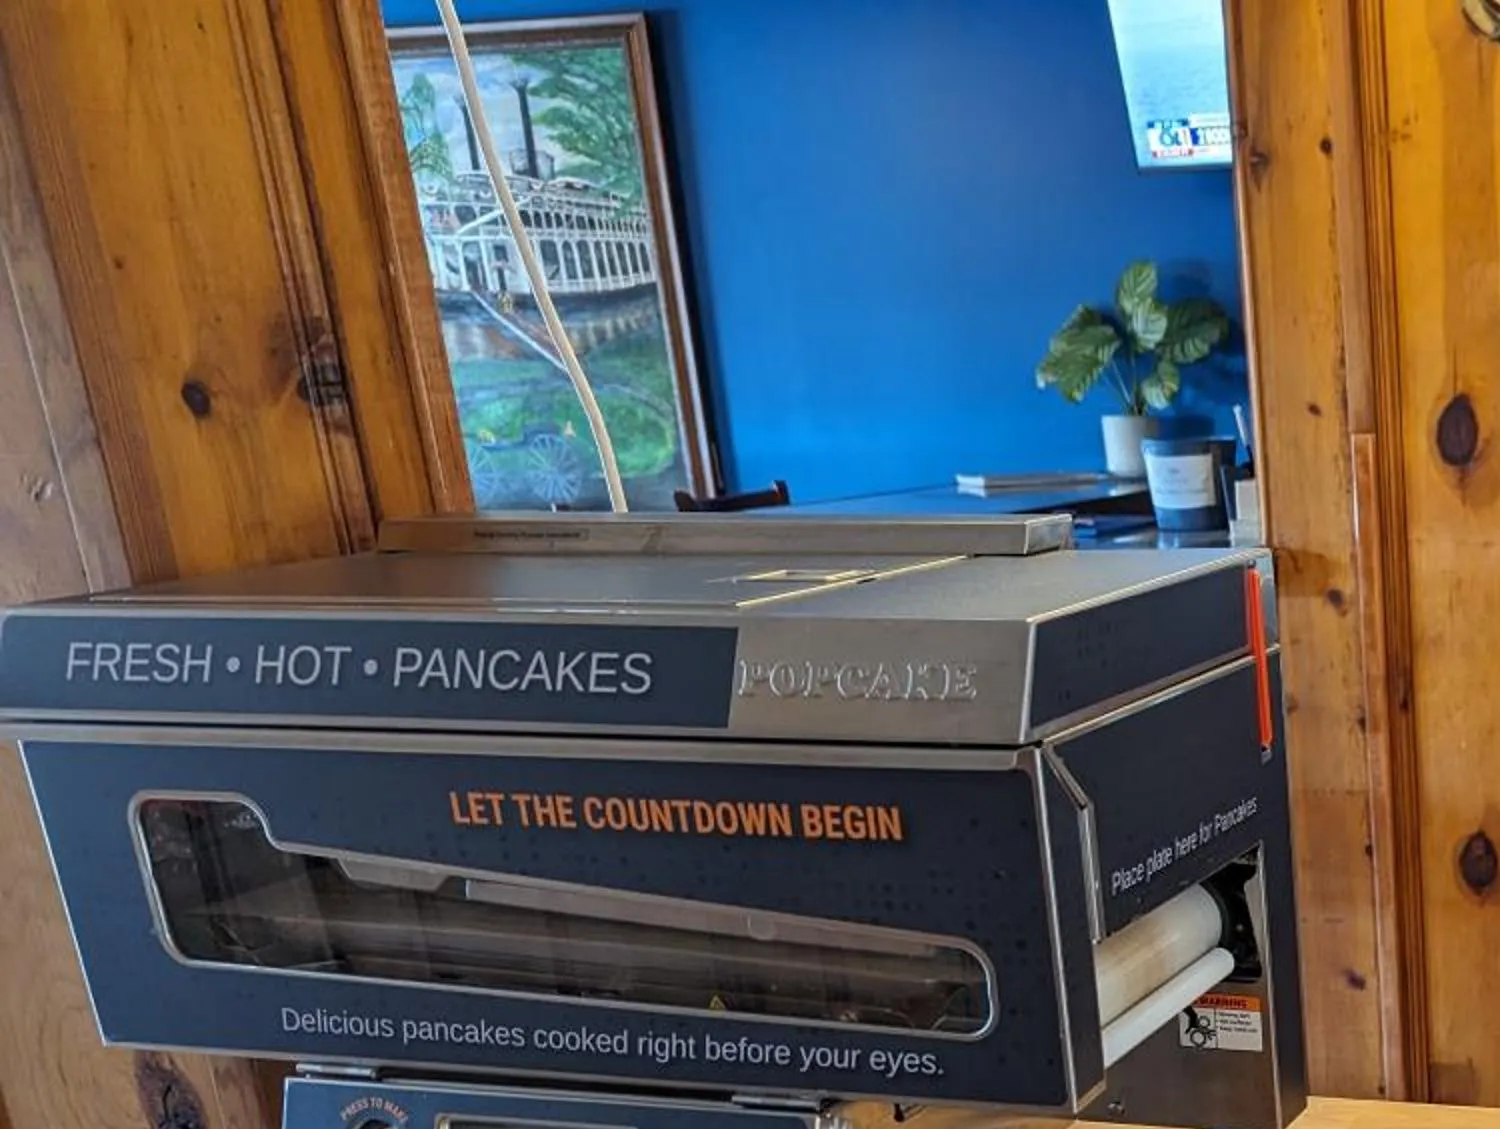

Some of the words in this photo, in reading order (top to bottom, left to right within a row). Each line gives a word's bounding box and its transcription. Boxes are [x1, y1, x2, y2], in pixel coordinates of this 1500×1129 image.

[66, 642, 212, 683] FRESH
[255, 646, 351, 686] HOT
[393, 648, 653, 695] PANCAKES
[736, 659, 979, 700] POPCAKE
[449, 791, 504, 825] LET
[511, 794, 577, 829] THE
[583, 797, 793, 837] COUNTDOWN
[801, 804, 904, 842] BEGIN
[1111, 861, 1146, 896] Place
[1146, 845, 1173, 883] plate
[1174, 831, 1199, 860] here
[1199, 820, 1214, 846] for
[281, 1006, 395, 1040] Delicious
[402, 1016, 526, 1050] pancakes
[532, 1023, 629, 1055] cooked
[637, 1030, 698, 1064] right
[704, 1034, 792, 1066] before
[798, 1046, 861, 1080] your
[868, 1048, 946, 1078] eyes.
